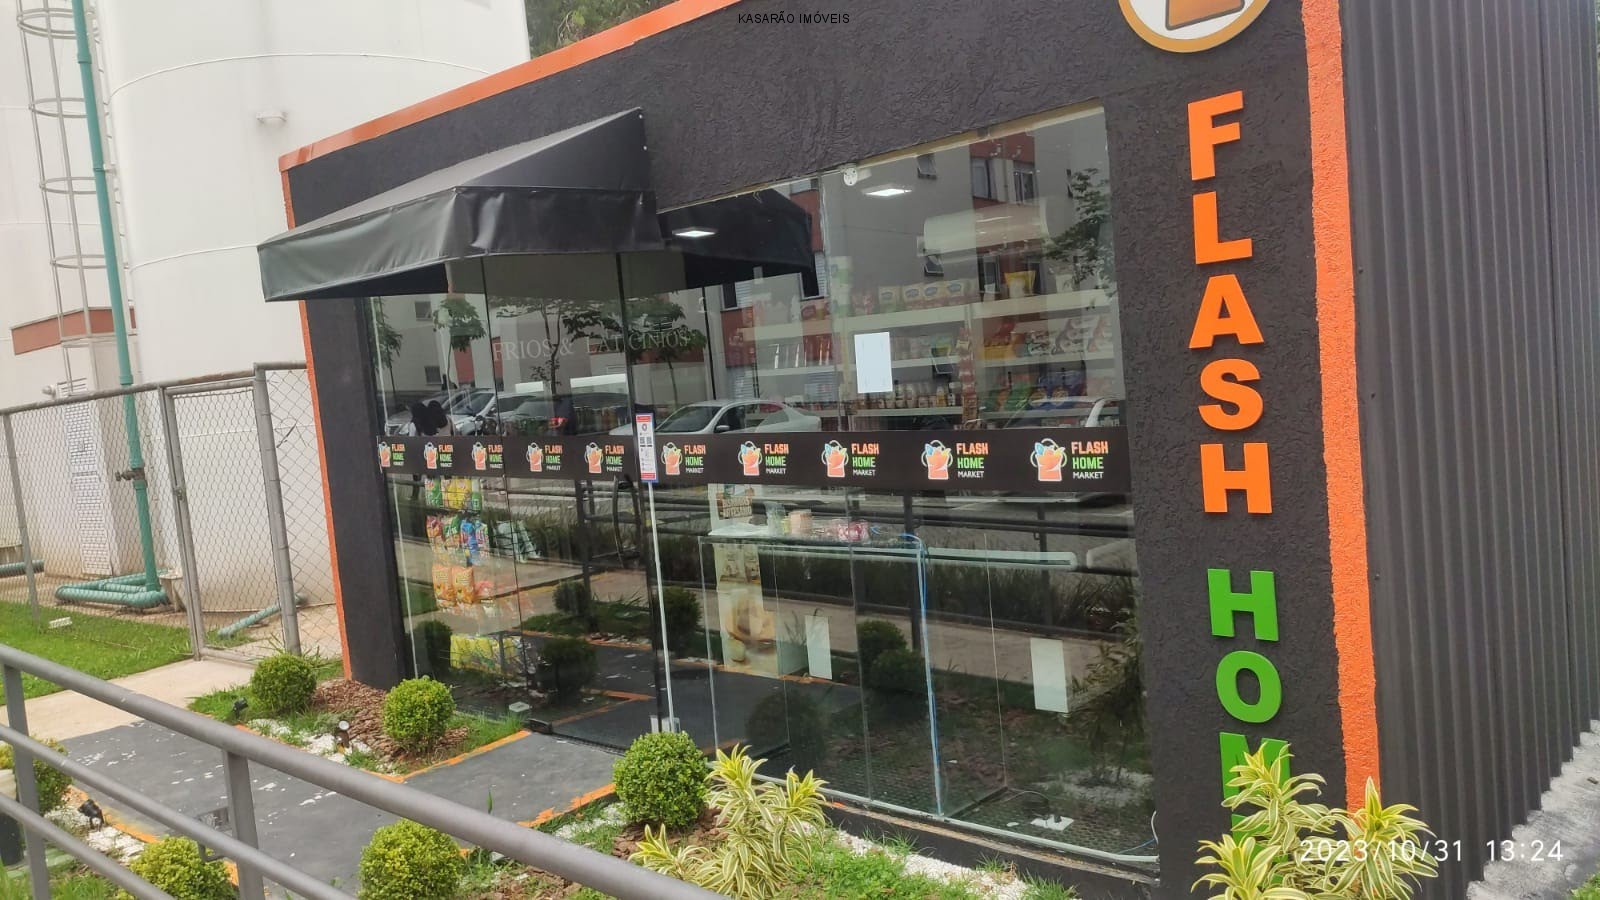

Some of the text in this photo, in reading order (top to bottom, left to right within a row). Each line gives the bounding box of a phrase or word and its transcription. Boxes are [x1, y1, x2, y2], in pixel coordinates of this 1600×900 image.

[1187, 90, 1272, 514] FLASH
[492, 338, 552, 361] FRIOS
[559, 337, 574, 356] &
[684, 444, 706, 455] FLASH
[764, 443, 789, 454] FLASH
[851, 443, 880, 455] FLASH
[956, 442, 989, 455] FLASH
[1071, 441, 1109, 454] FLASH
[685, 456, 704, 466] HOME
[765, 456, 787, 467] HOME
[852, 456, 876, 468] HOME
[957, 457, 985, 469] HOME
[1072, 456, 1104, 470] HOME
[957, 470, 985, 478] MARKET
[1072, 471, 1104, 479] MARKET
